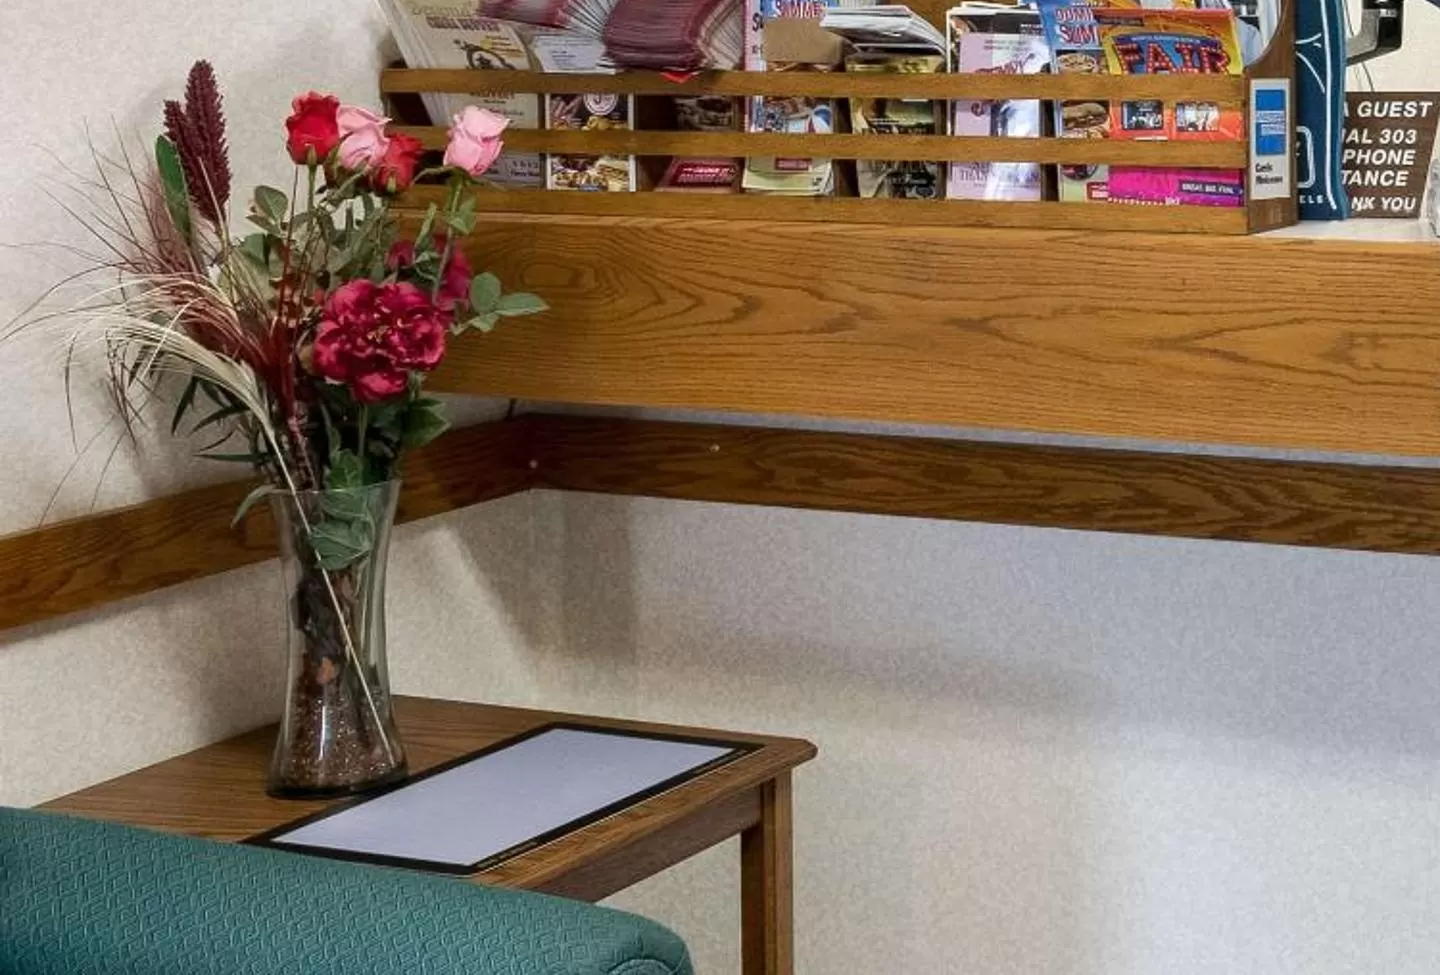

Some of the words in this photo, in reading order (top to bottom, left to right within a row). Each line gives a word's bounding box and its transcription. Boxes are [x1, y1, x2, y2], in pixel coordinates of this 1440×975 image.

[1114, 41, 1231, 75] FAIR
[1356, 100, 1433, 118] GUEST
[1341, 128, 1373, 145] IAL
[1379, 128, 1418, 145] 303
[1342, 148, 1417, 166] PHONE
[1340, 169, 1410, 186] TANCE
[1350, 195, 1376, 212] NK
[1381, 196, 1417, 212] YOU
